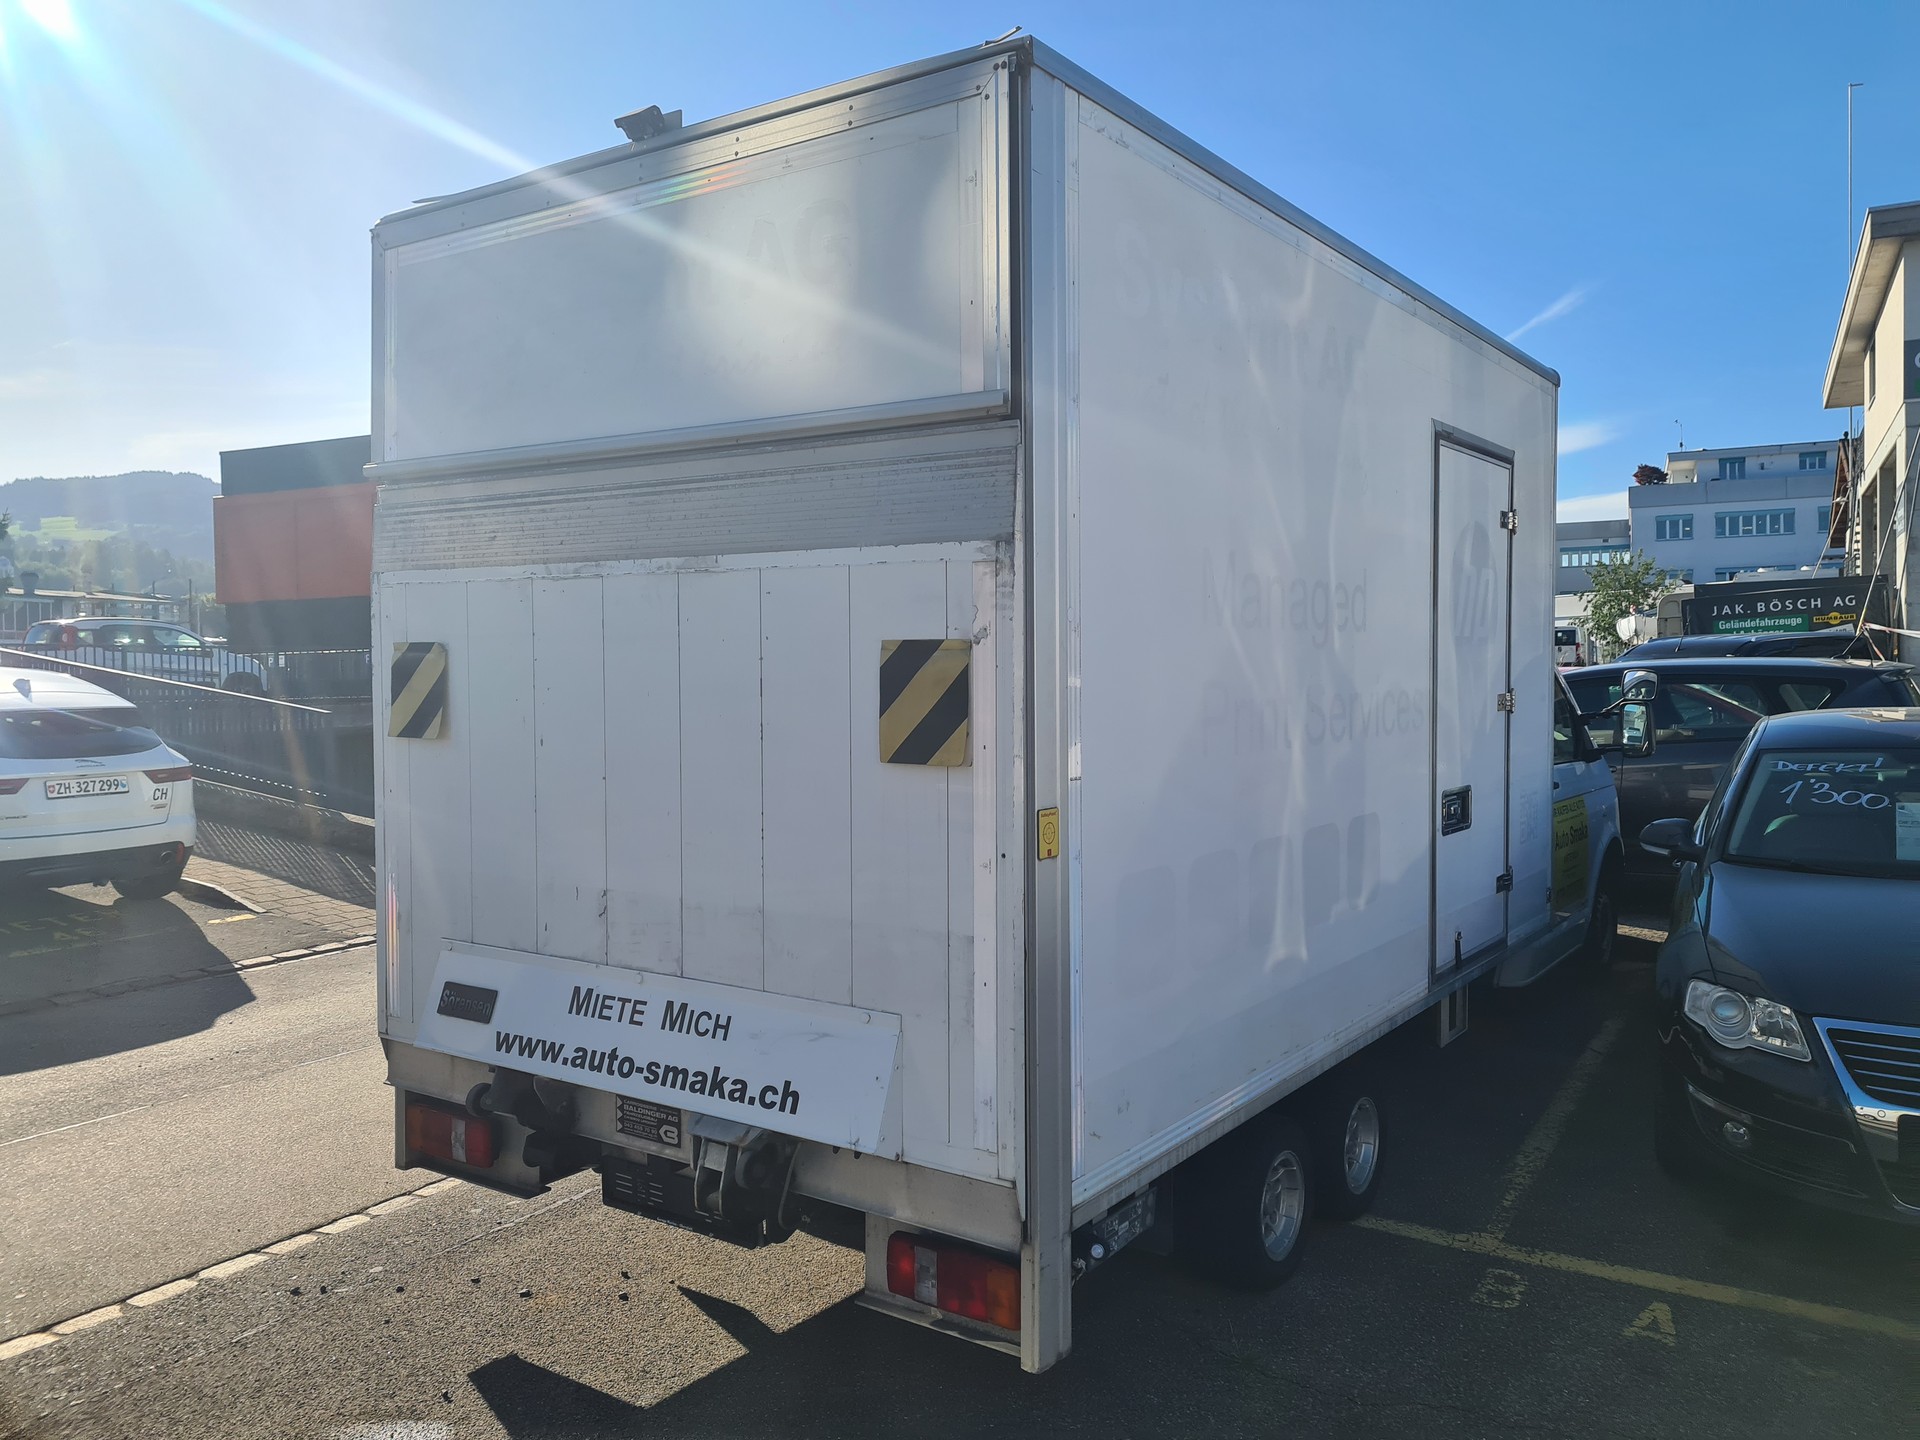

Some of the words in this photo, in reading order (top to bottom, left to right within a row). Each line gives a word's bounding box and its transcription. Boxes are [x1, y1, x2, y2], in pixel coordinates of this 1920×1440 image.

[1757, 597, 1822, 614] BÖSCH
[1833, 594, 1857, 607] AG
[1718, 616, 1803, 631] Geländefahrzeuge
[152, 788, 169, 801] CH
[567, 985, 648, 1027] MIETE
[660, 999, 733, 1042] MICH
[495, 1030, 801, 1115] www.auto-smaka.ch
[623, 1104, 667, 1120] BALDINGER
[1621, 1301, 1677, 1347] A
